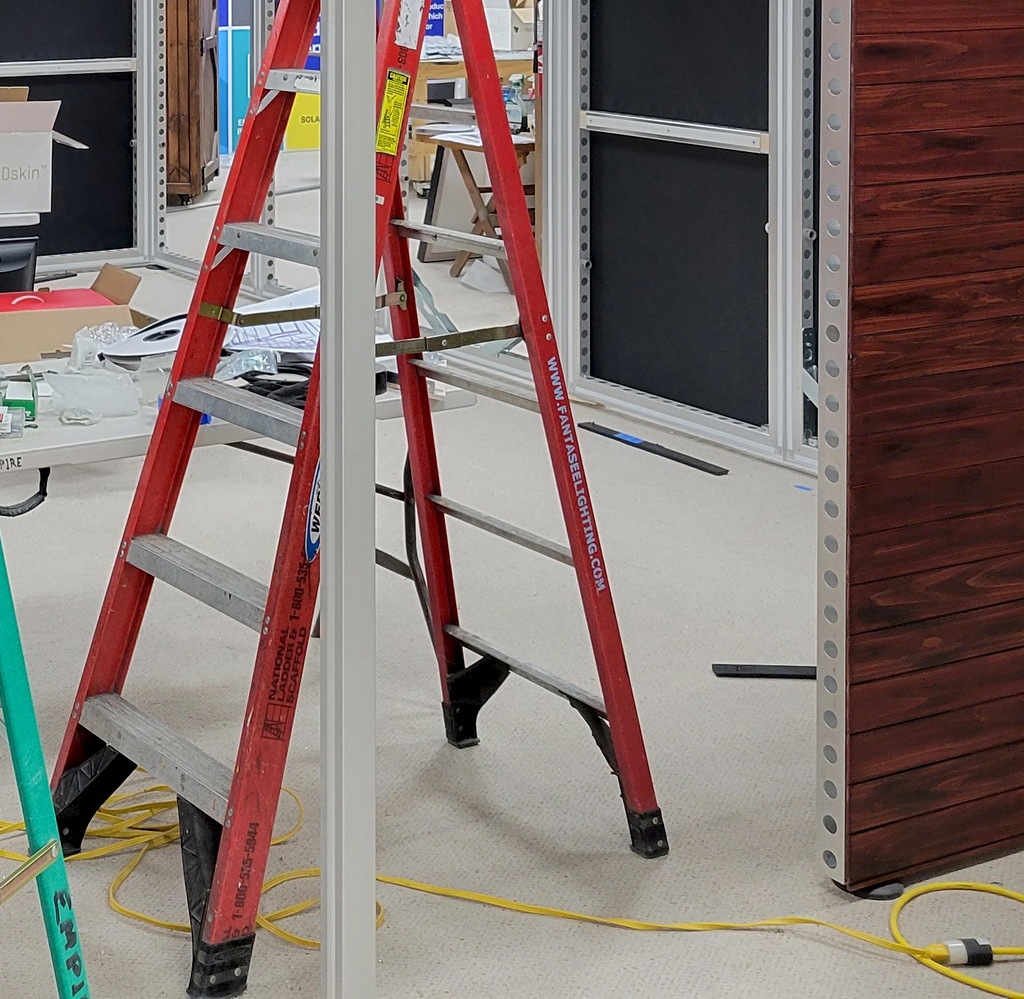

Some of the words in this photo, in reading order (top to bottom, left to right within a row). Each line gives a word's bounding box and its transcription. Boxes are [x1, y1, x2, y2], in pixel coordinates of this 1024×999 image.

[547, 356, 606, 593] WWW.FANTASEELIGHTING.COM
[269, 625, 290, 701] NATIONAL
[277, 642, 295, 703] LADDER
[285, 626, 307, 703] SCAFFOLD
[53, 889, 88, 999] EMPI
